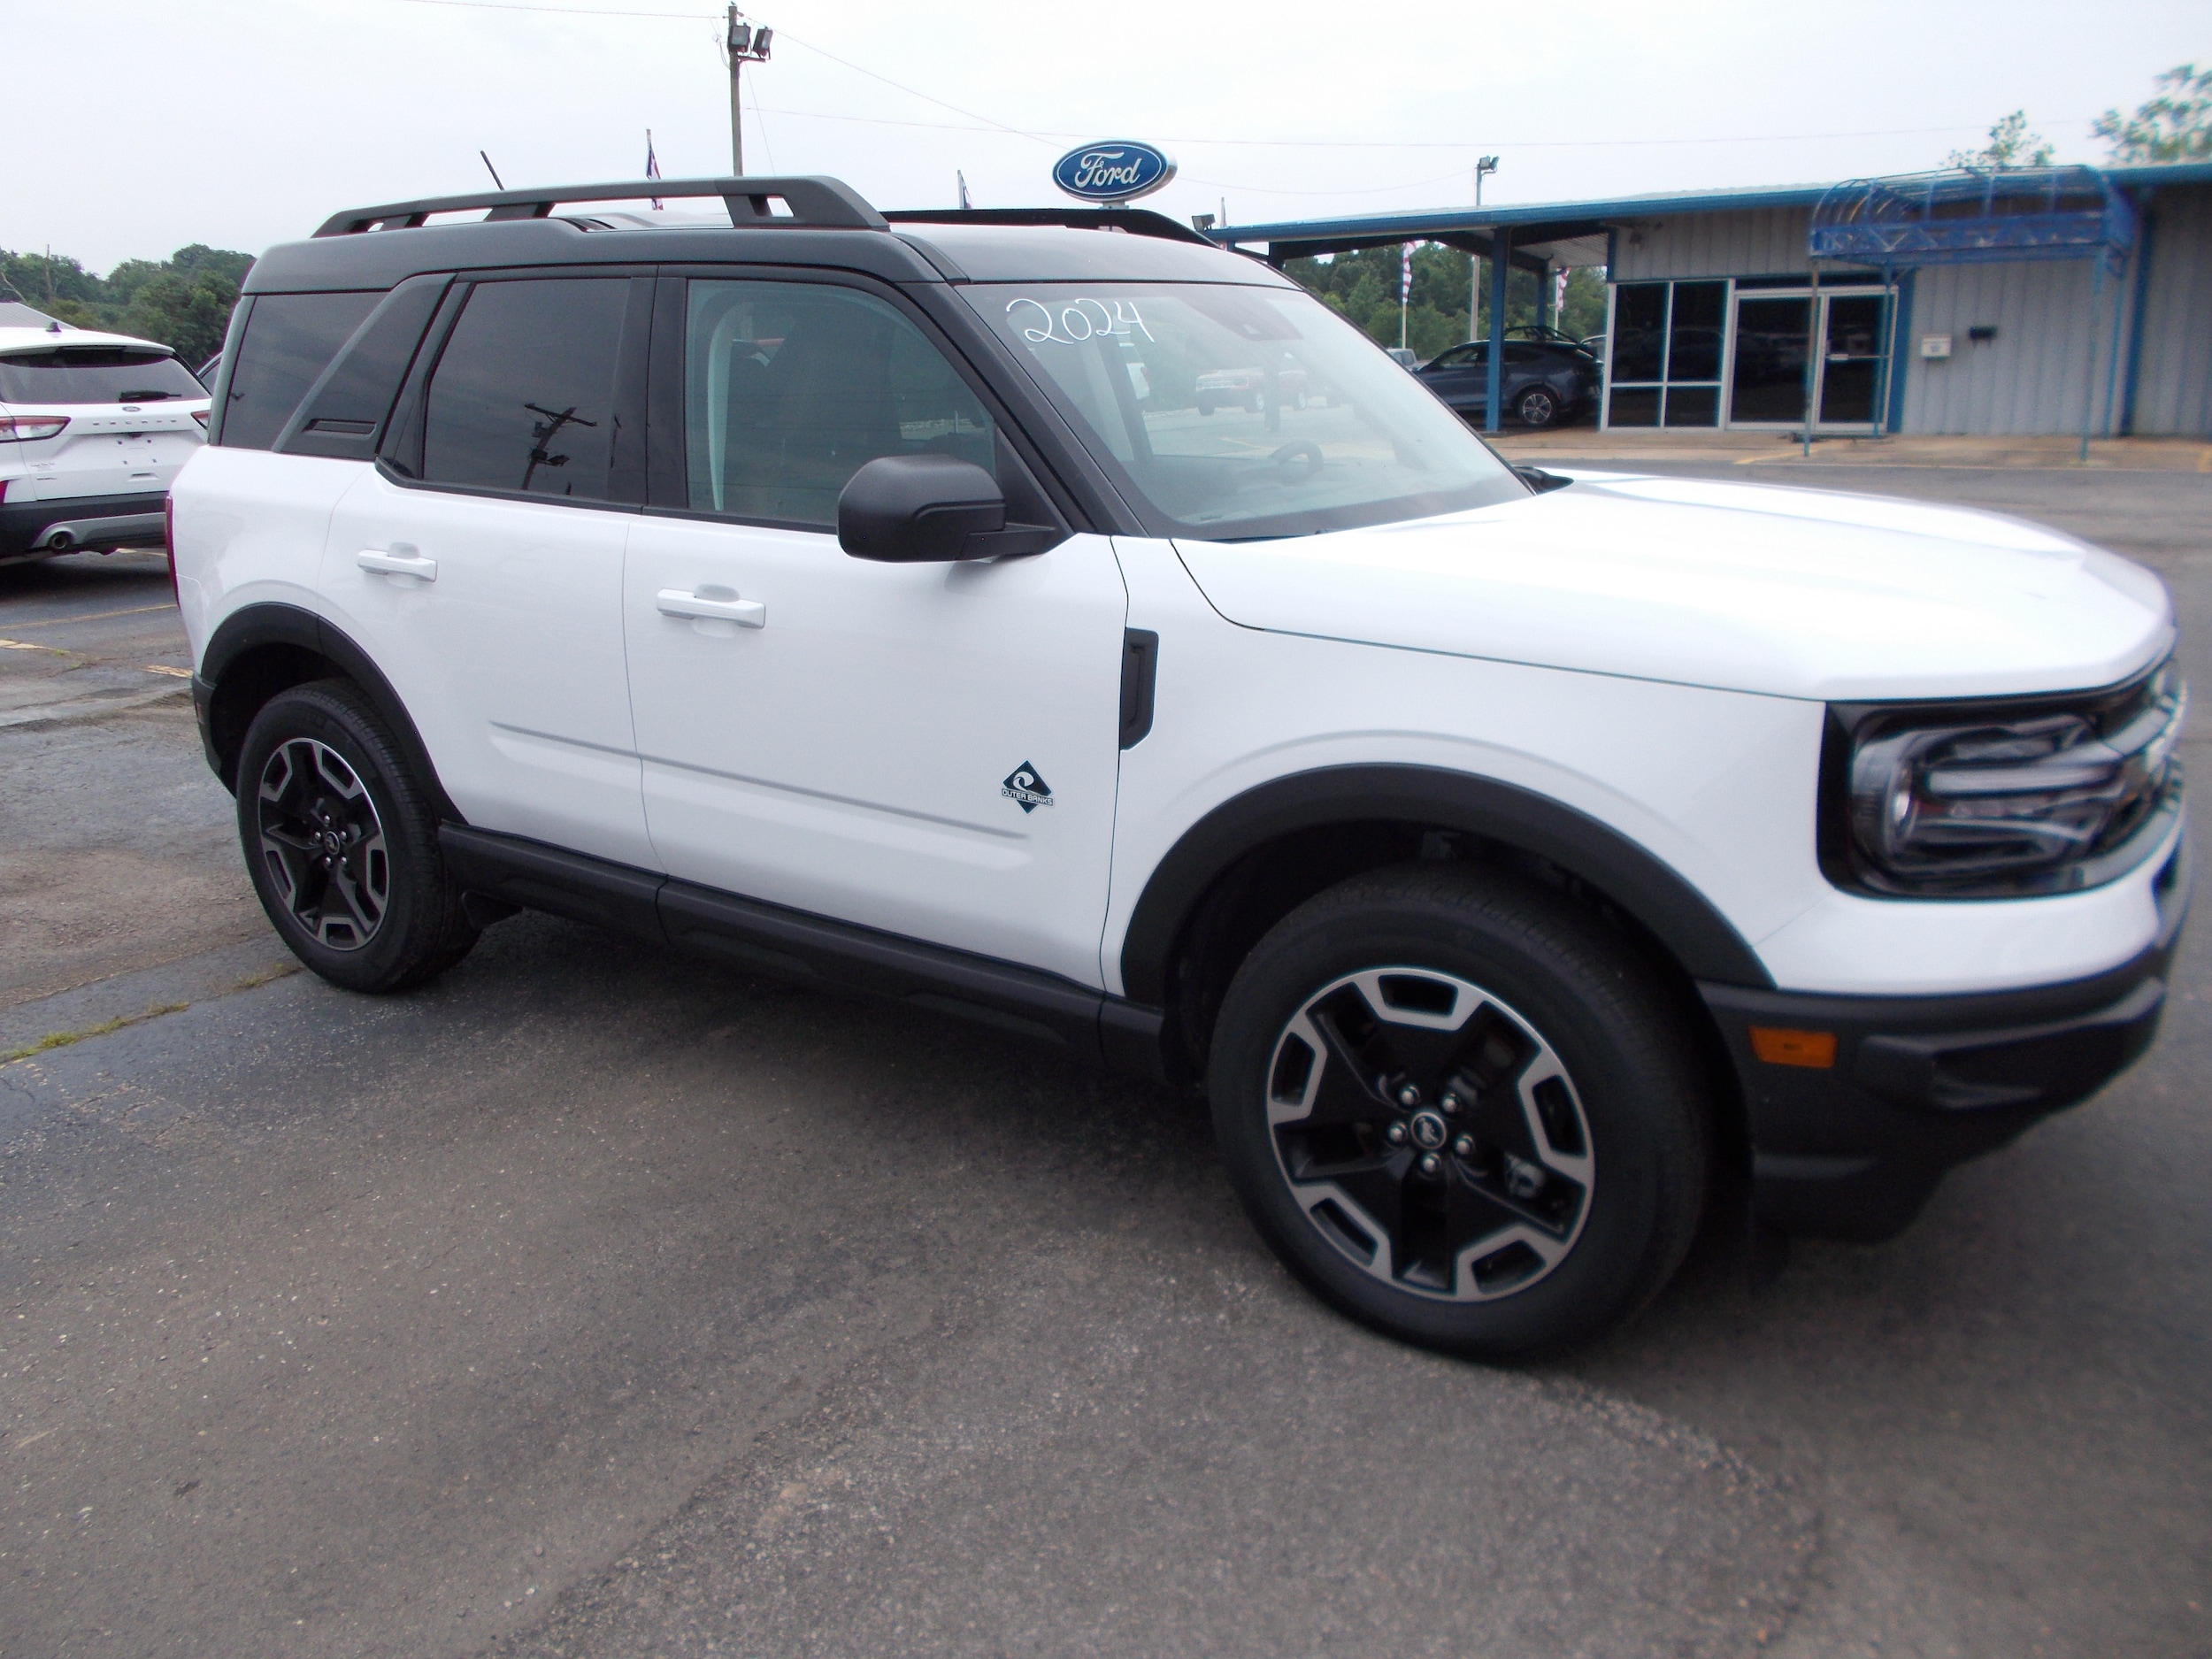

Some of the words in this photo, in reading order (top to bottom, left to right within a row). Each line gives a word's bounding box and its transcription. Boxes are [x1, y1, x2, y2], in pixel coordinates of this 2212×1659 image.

[1074, 151, 1141, 188] Ford
[1005, 297, 1156, 345] 2024
[1002, 789, 1026, 800] OUTER
[1027, 794, 1053, 805] BANKS
